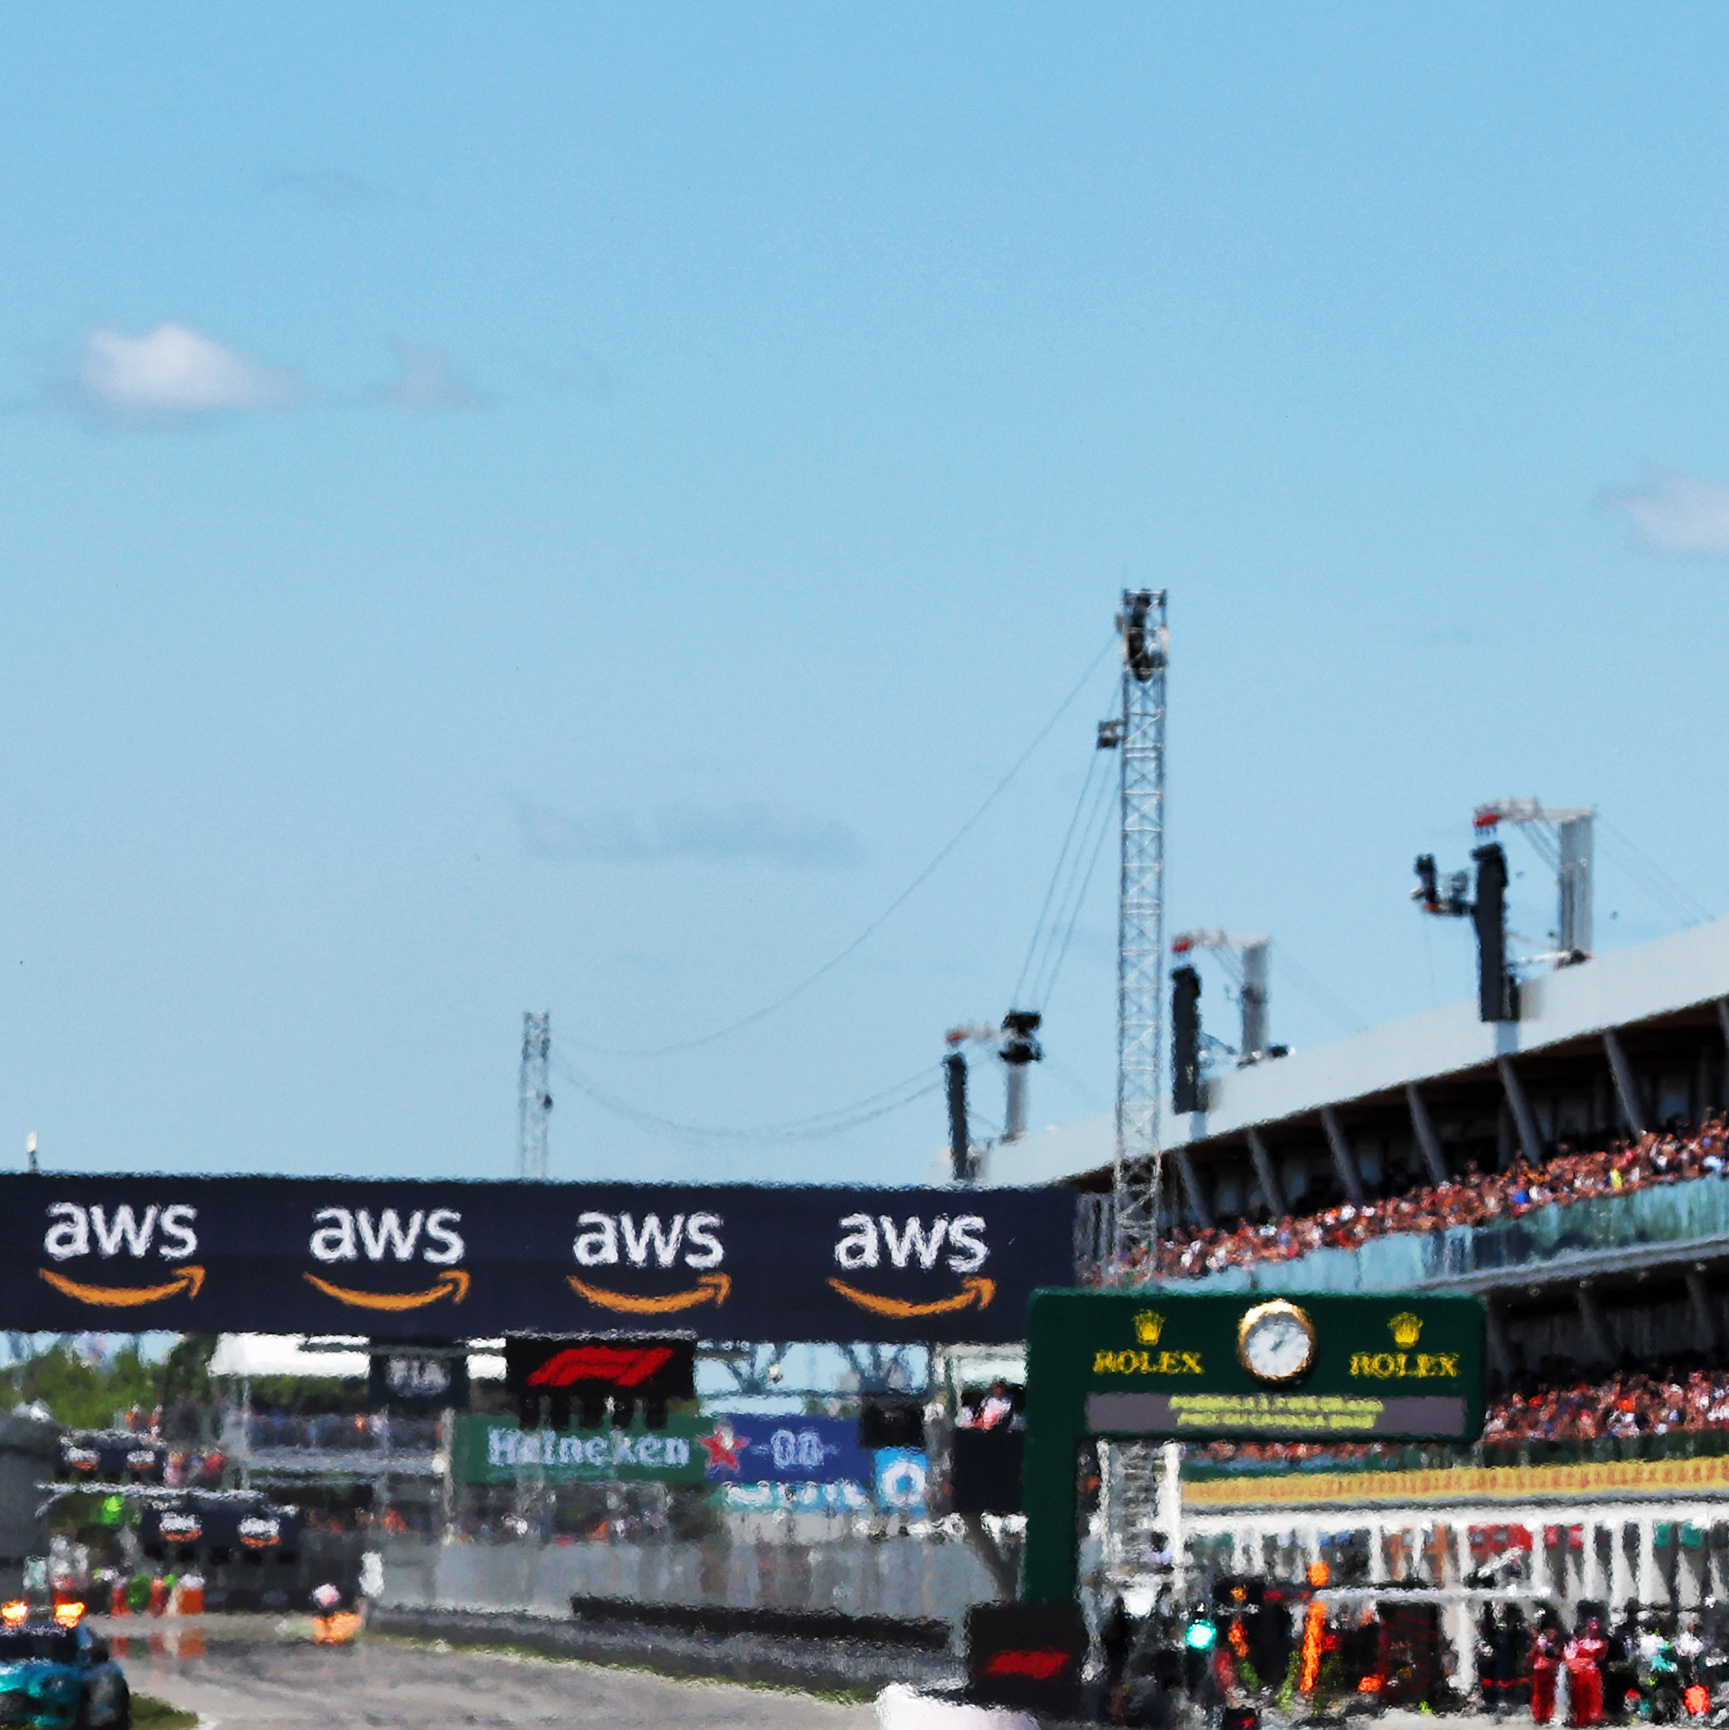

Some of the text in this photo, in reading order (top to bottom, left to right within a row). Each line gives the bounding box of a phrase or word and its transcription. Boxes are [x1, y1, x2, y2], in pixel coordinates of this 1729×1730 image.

[43, 1201, 198, 1260] aws
[309, 1206, 465, 1265] aws
[573, 1210, 723, 1269] aws
[833, 1212, 991, 1272] aws
[1092, 1350, 1204, 1377] ROLEX
[1349, 1353, 1461, 1378] ROLEX
[487, 1426, 690, 1468] Heineken
